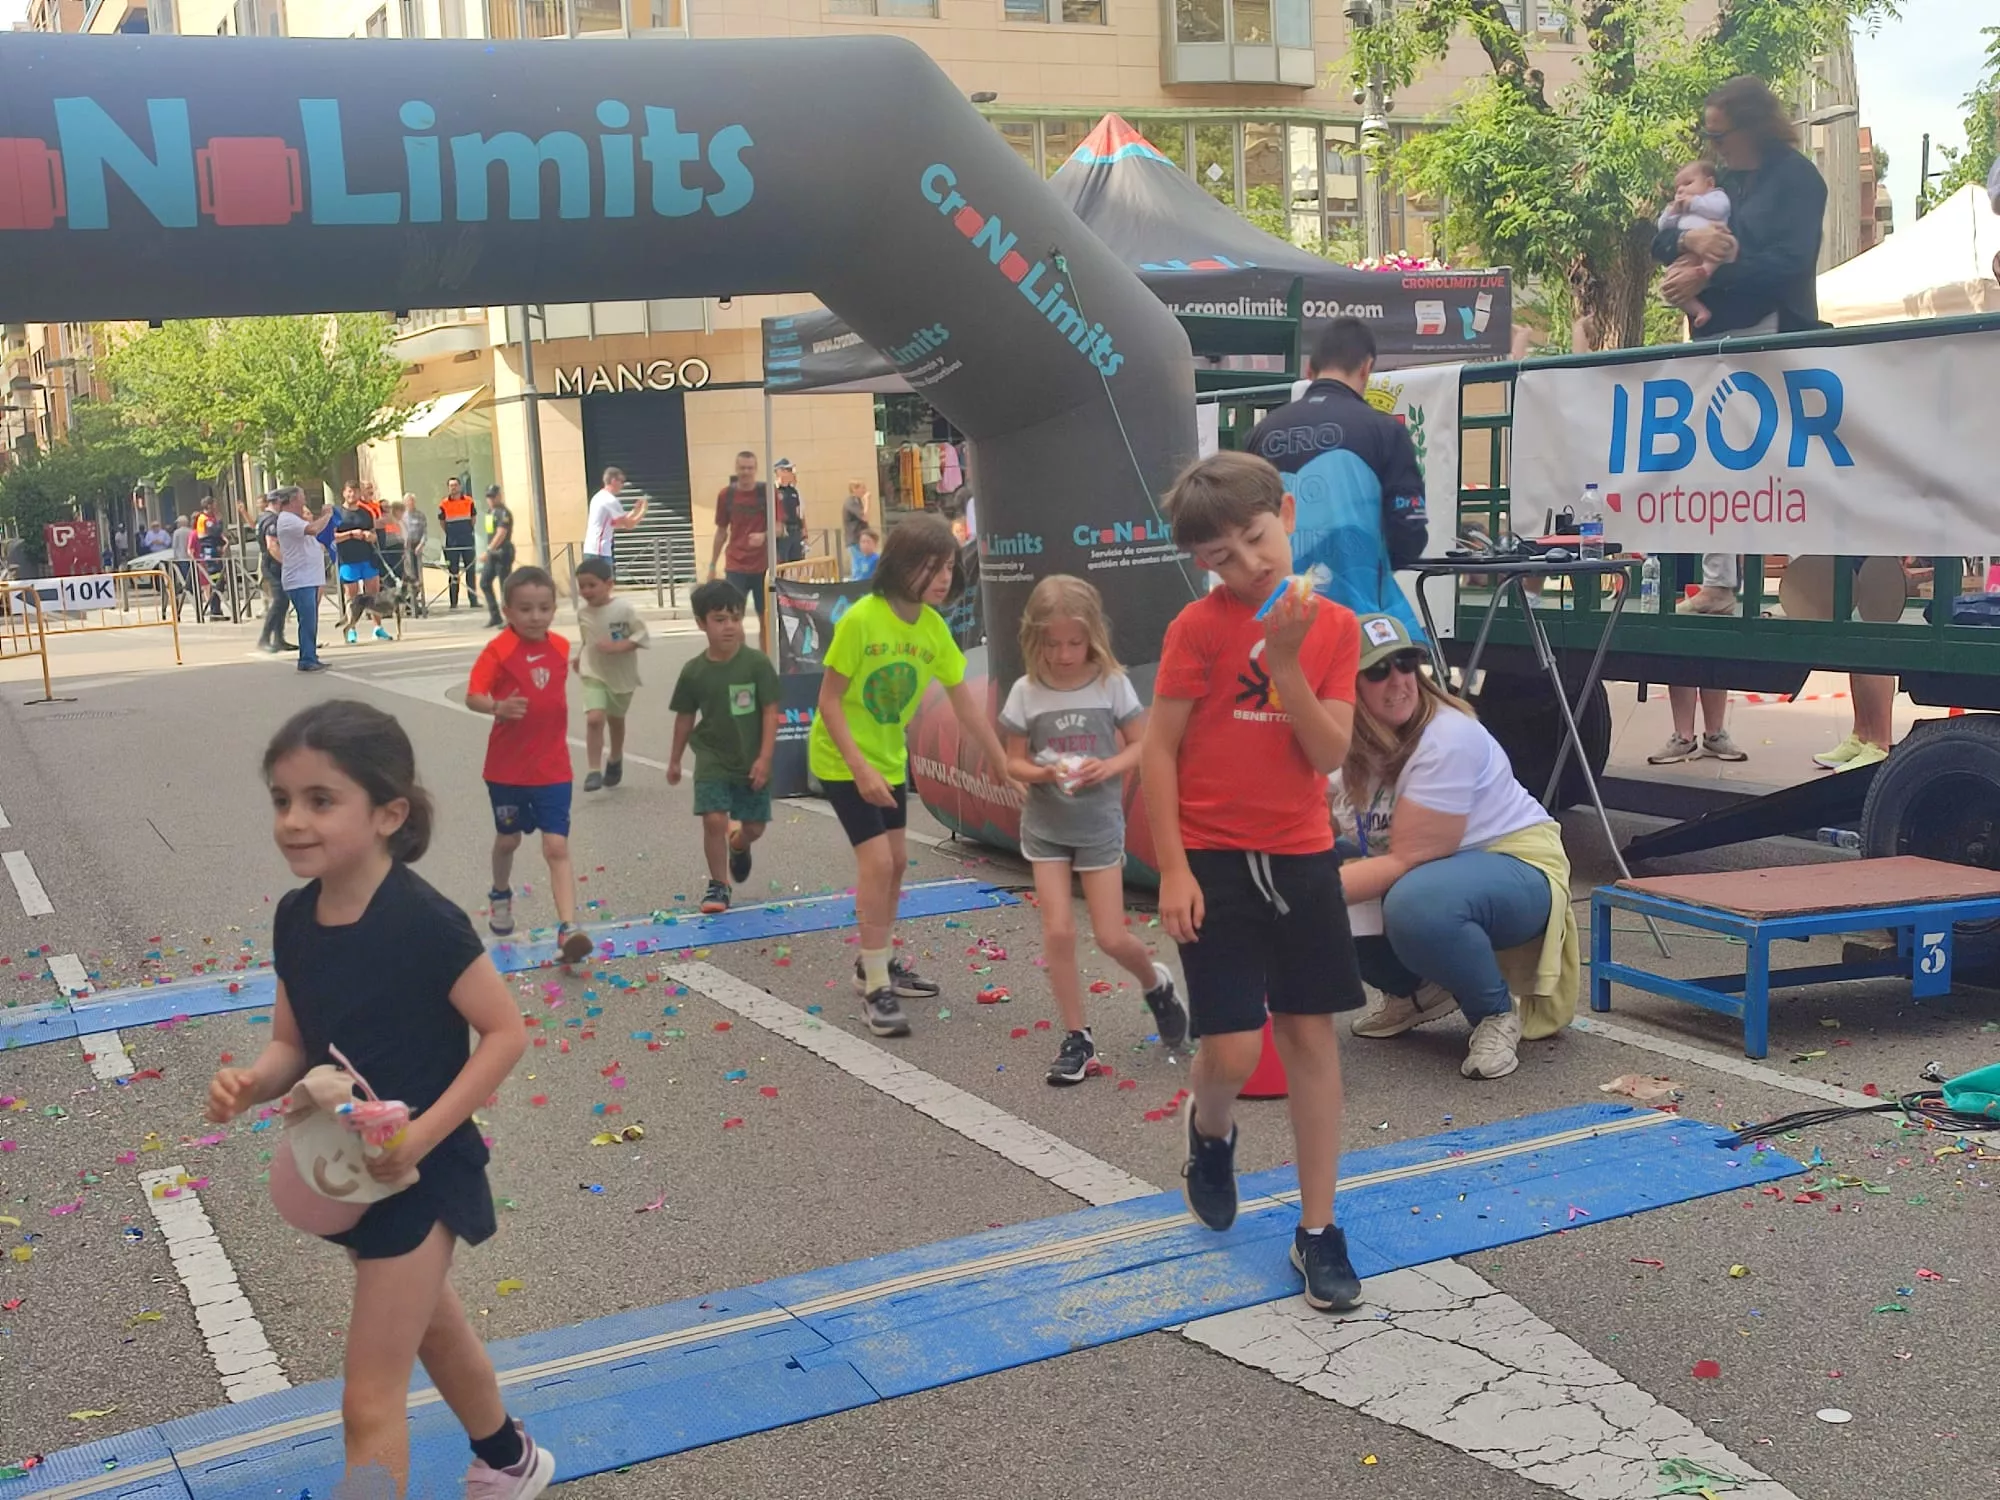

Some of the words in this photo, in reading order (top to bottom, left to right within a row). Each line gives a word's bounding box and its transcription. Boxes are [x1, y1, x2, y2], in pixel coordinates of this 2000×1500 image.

[1402, 277, 1477, 289] CRONOLIMITS
[1481, 276, 1505, 288] LIVE
[555, 358, 710, 396] MANGO
[1608, 368, 1855, 474] IBOR
[1637, 475, 1806, 535] ortopedia
[1124, 546, 1135, 555] de
[1120, 557, 1130, 567] de
[65, 580, 113, 602] 10K
[1055, 713, 1087, 731] GIVE
[1919, 932, 1947, 975] 3
